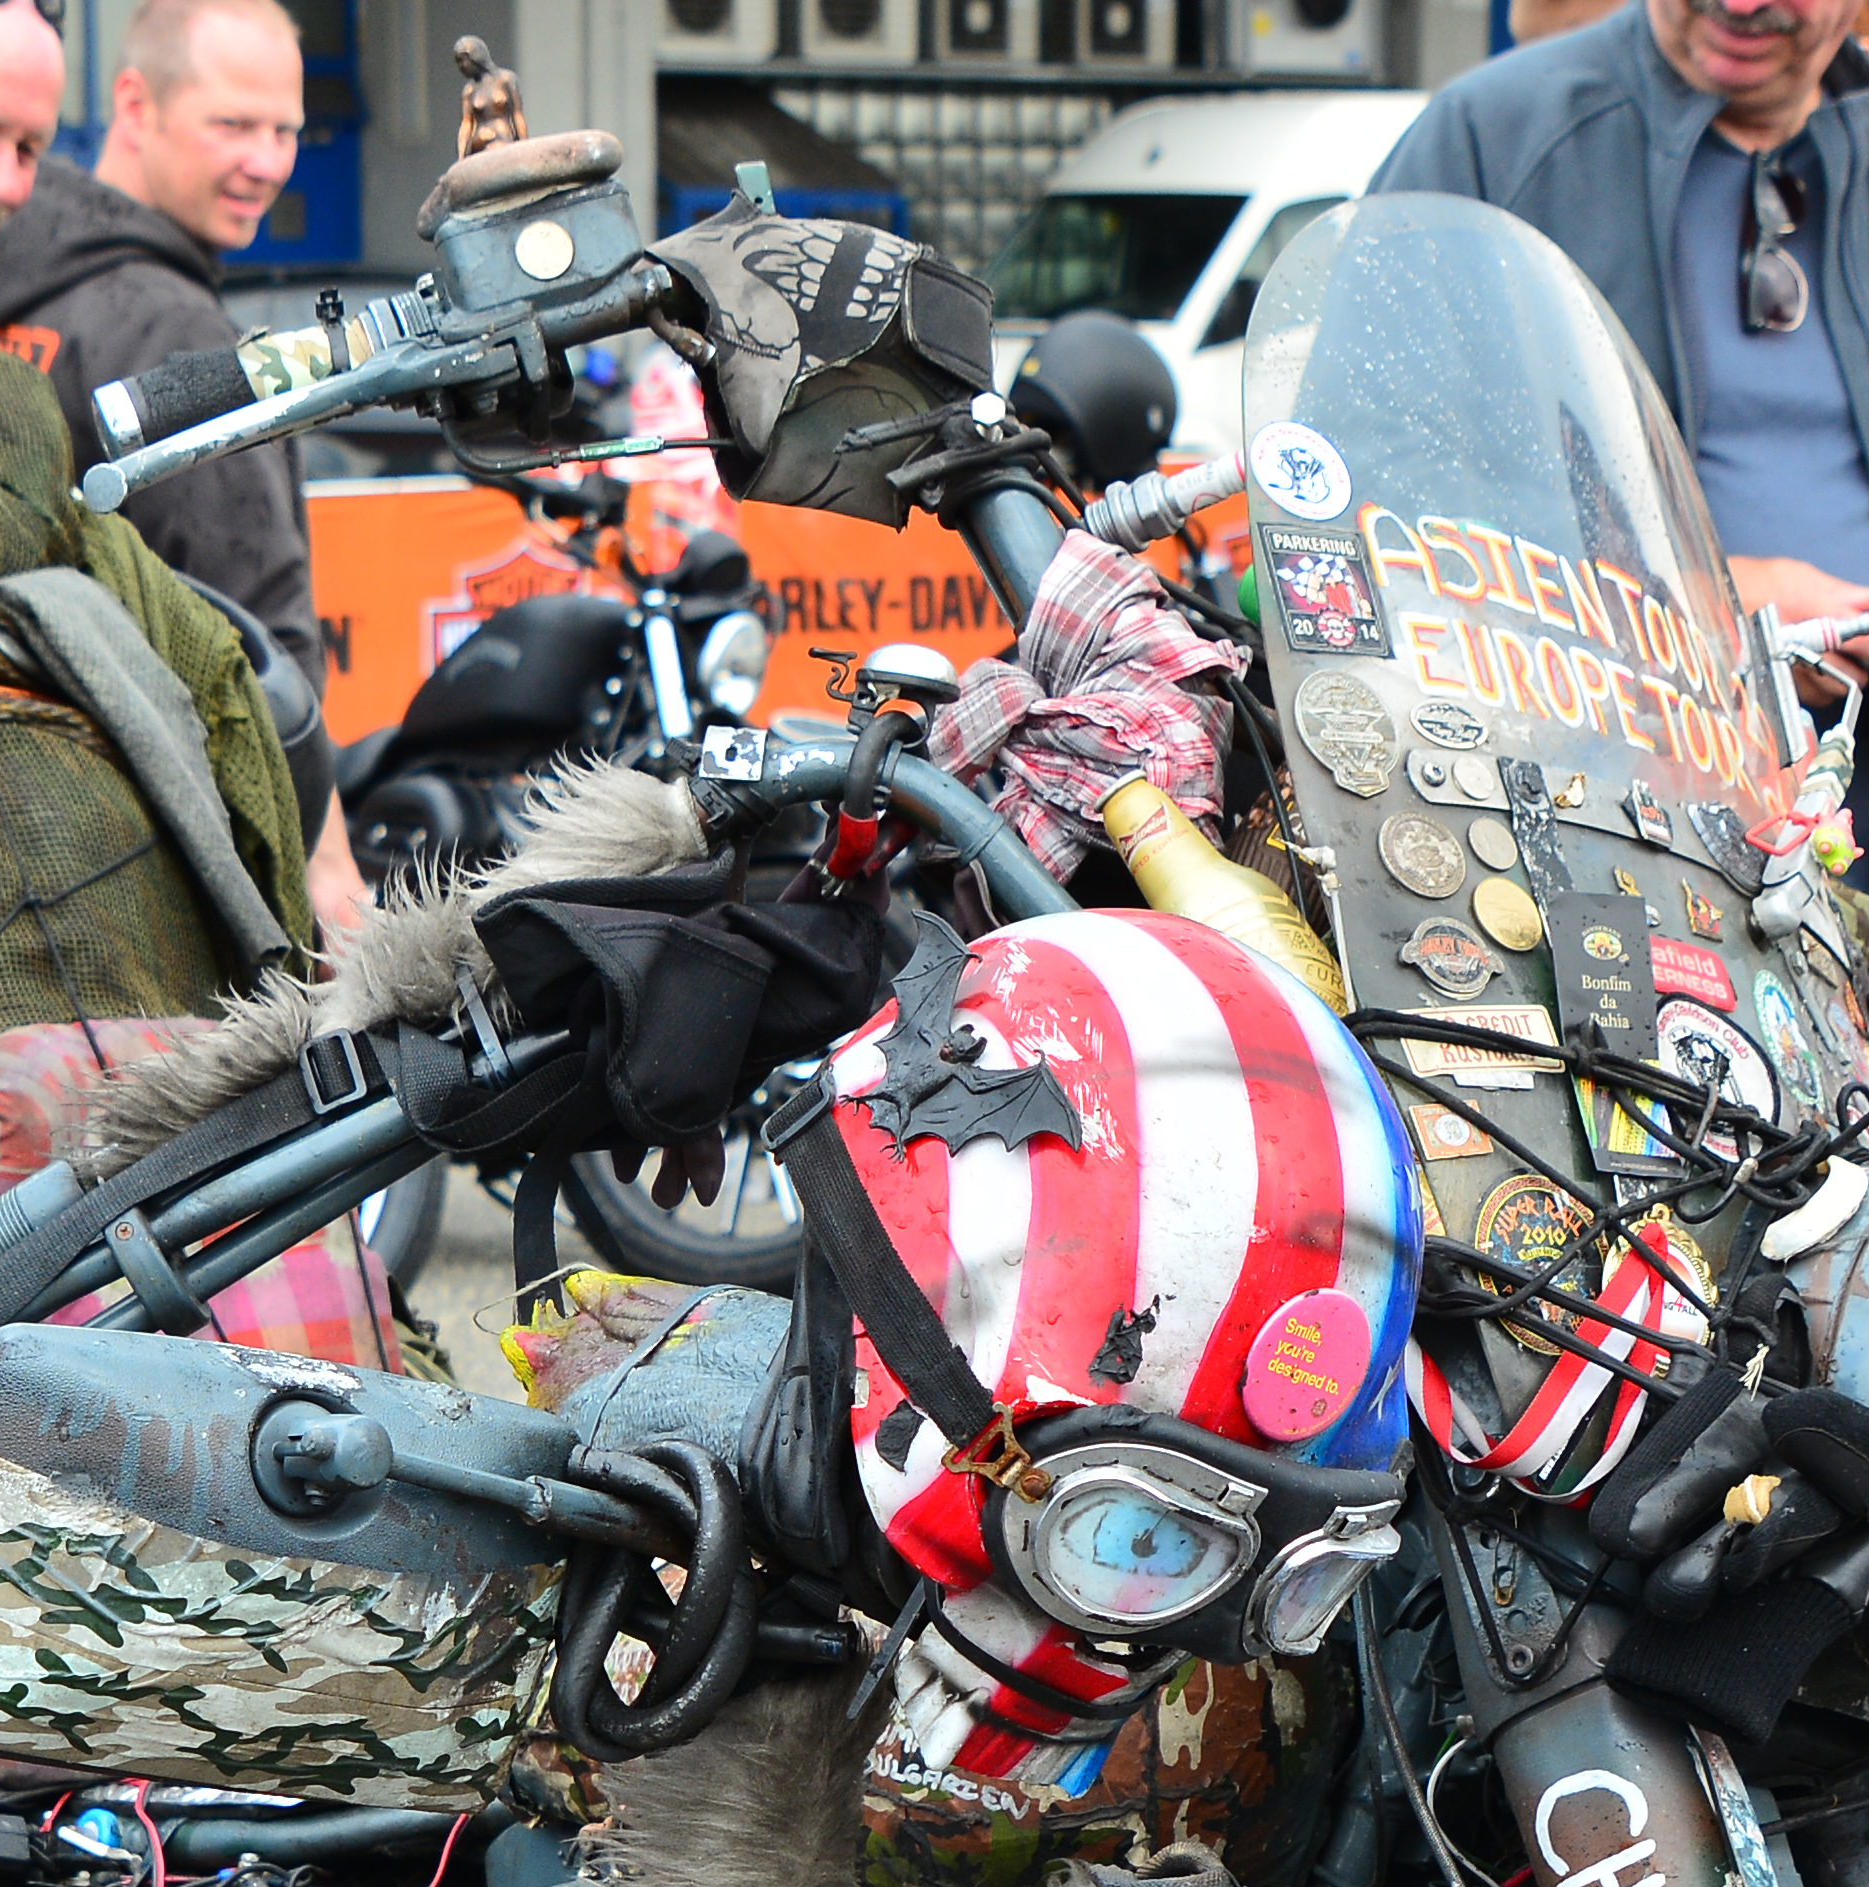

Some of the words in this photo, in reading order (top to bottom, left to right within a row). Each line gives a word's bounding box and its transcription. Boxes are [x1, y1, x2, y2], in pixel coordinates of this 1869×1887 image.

[1272, 533, 1357, 557] PARKERING
[1357, 502, 1616, 649] ASIEN
[1595, 558, 1733, 719] TOUR
[1292, 618, 1314, 637] 20
[1360, 623, 1380, 641] 14
[1398, 612, 1656, 753] EUROPE
[1641, 674, 1759, 806] TOUR
[1652, 945, 1719, 978] afield
[1581, 974, 1632, 992] Bonfim
[1652, 965, 1728, 1001] ERNESS
[1599, 994, 1618, 1010] da
[1589, 1011, 1631, 1030] Bahia
[1722, 1028, 1750, 1061] Club
[1520, 1222, 1568, 1246] 2010
[1285, 1317, 1323, 1347] Smile,
[1274, 1339, 1316, 1364] you're
[1267, 1357, 1327, 1390] designed
[1325, 1378, 1340, 1396] to.
